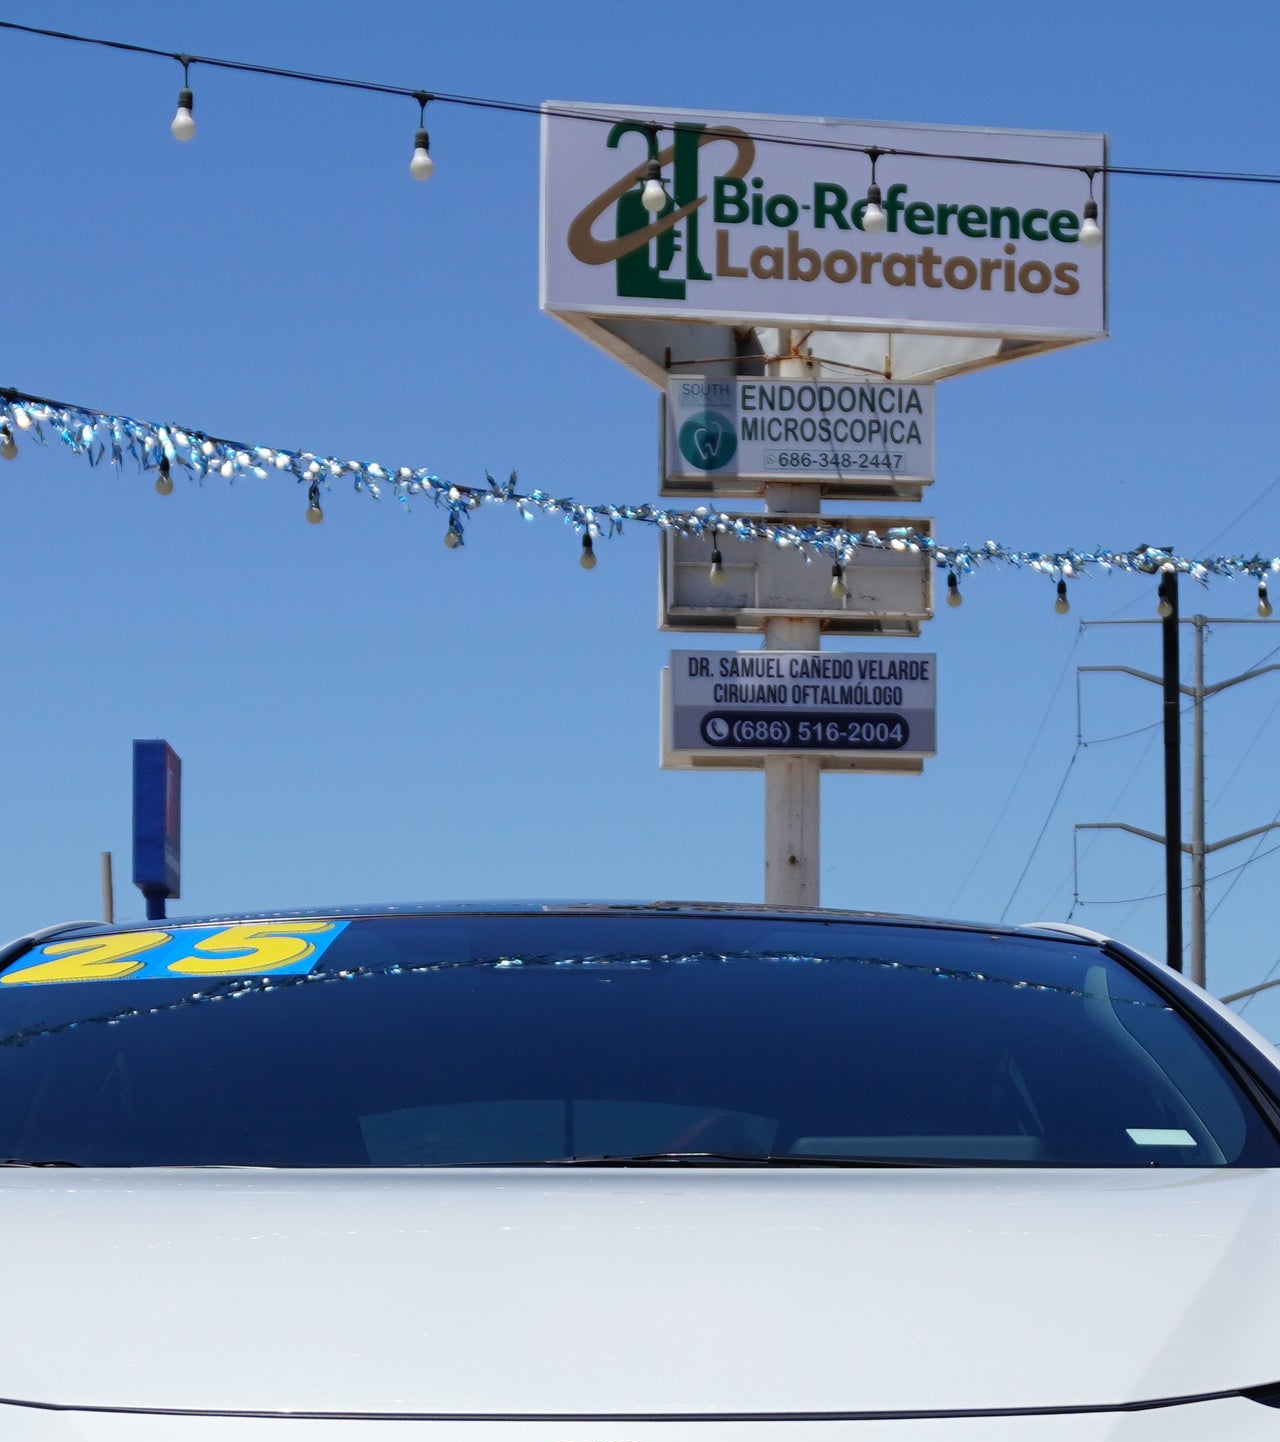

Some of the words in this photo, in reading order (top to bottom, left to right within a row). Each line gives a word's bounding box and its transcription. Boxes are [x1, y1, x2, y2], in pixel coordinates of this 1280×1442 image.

[713, 176, 1080, 243] Bio-Reference
[715, 229, 1080, 296] Laboratorios
[682, 383, 730, 396] SOUTH
[741, 384, 923, 414] ENDODONCIA
[741, 416, 922, 445] MICROSCOPICA
[778, 452, 903, 469] 686-348-2447
[688, 656, 714, 677] DR.
[720, 657, 784, 679] SAMUEL
[789, 654, 853, 680] CAÑEDO
[858, 659, 929, 681] VELARDE
[713, 683, 788, 704] CIRUJANO
[791, 682, 903, 706] OFTALMÓLOGO
[732, 719, 791, 744] (686)
[798, 722, 904, 743] 516-2004
[0, 922, 336, 985] 25
